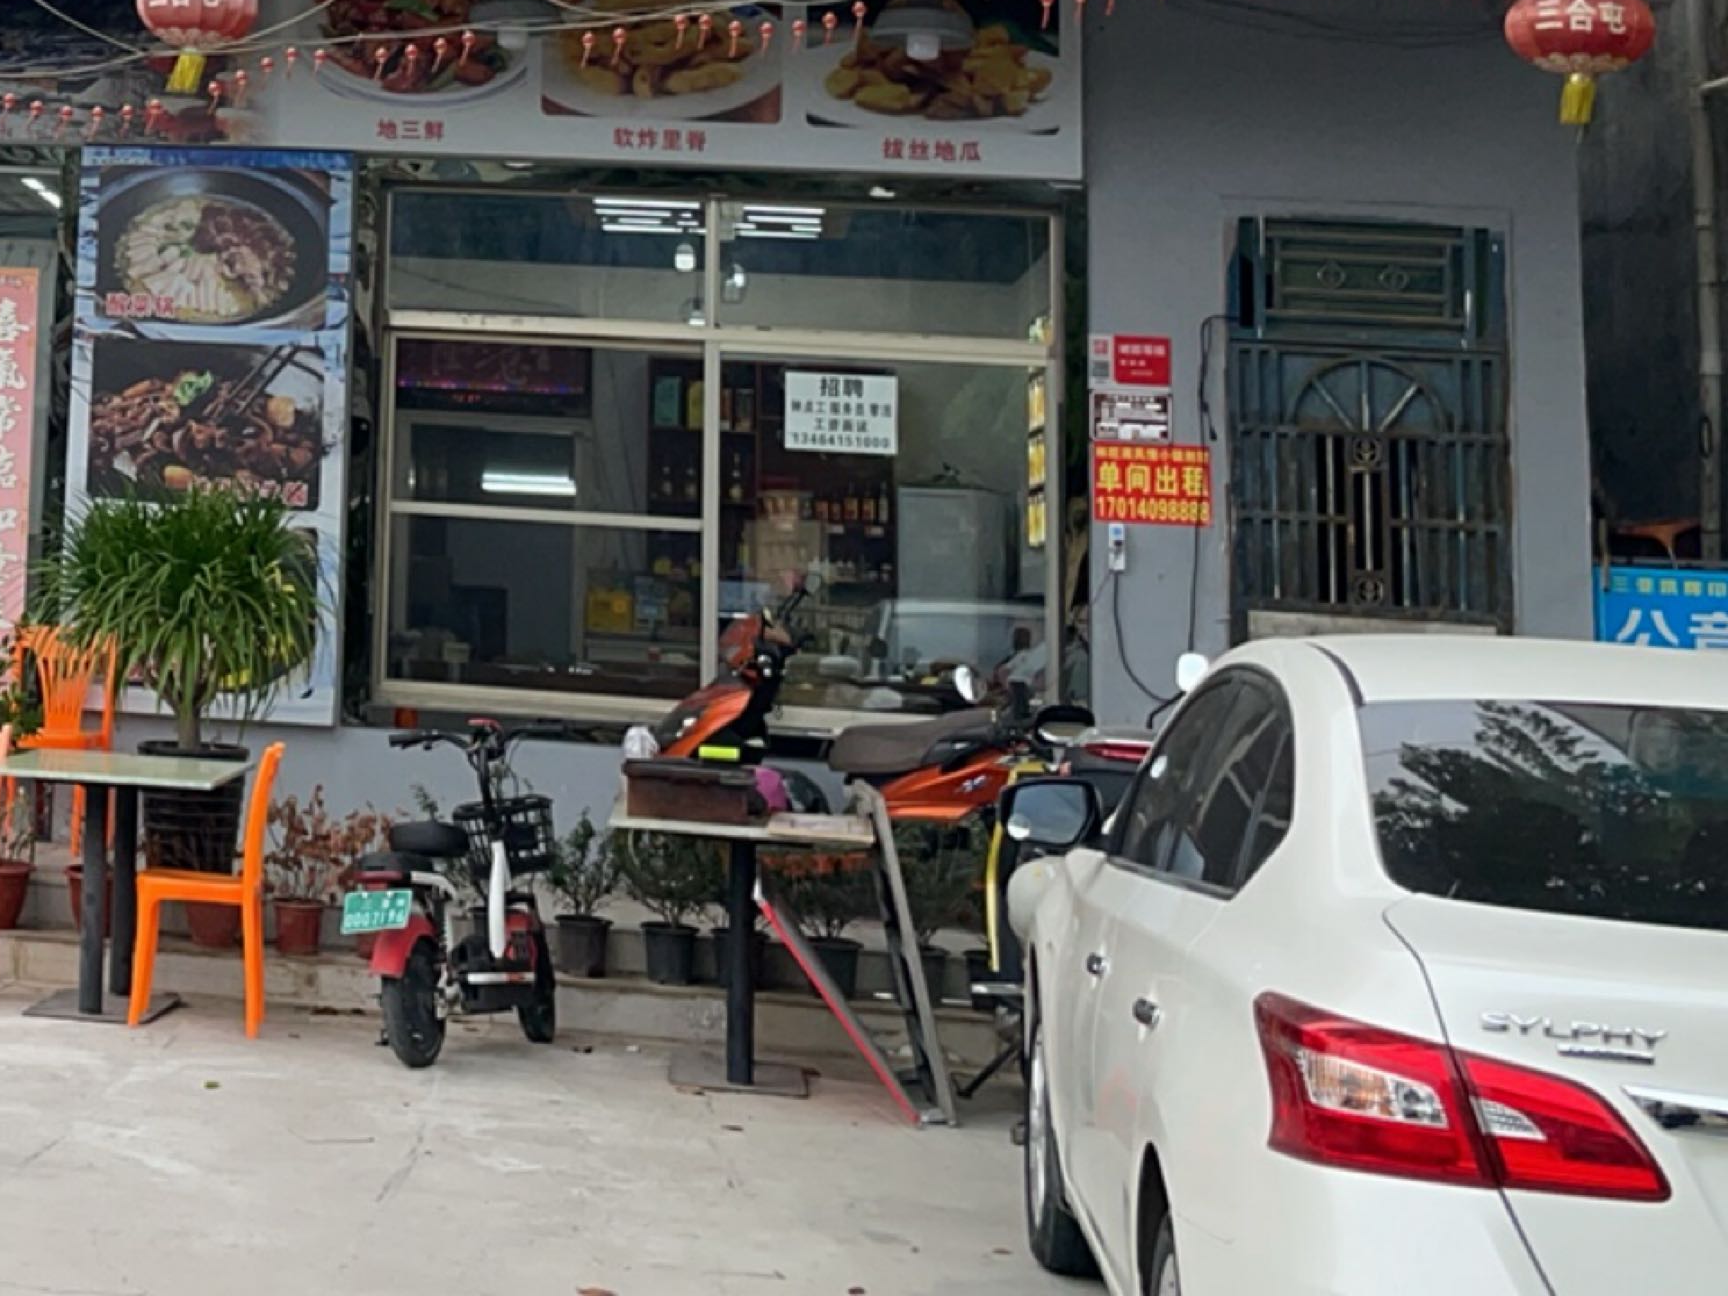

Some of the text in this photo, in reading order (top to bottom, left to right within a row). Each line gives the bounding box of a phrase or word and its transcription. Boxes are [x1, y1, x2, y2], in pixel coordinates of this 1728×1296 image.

[377, 118, 446, 142] 地三鲜
[612, 126, 707, 152] 软炸里脊
[883, 137, 982, 162] 拔丝地瓜
[819, 376, 865, 399] 招聘
[1095, 460, 1210, 497] 单间出租
[1480, 1011, 1668, 1049] SYLPHY
